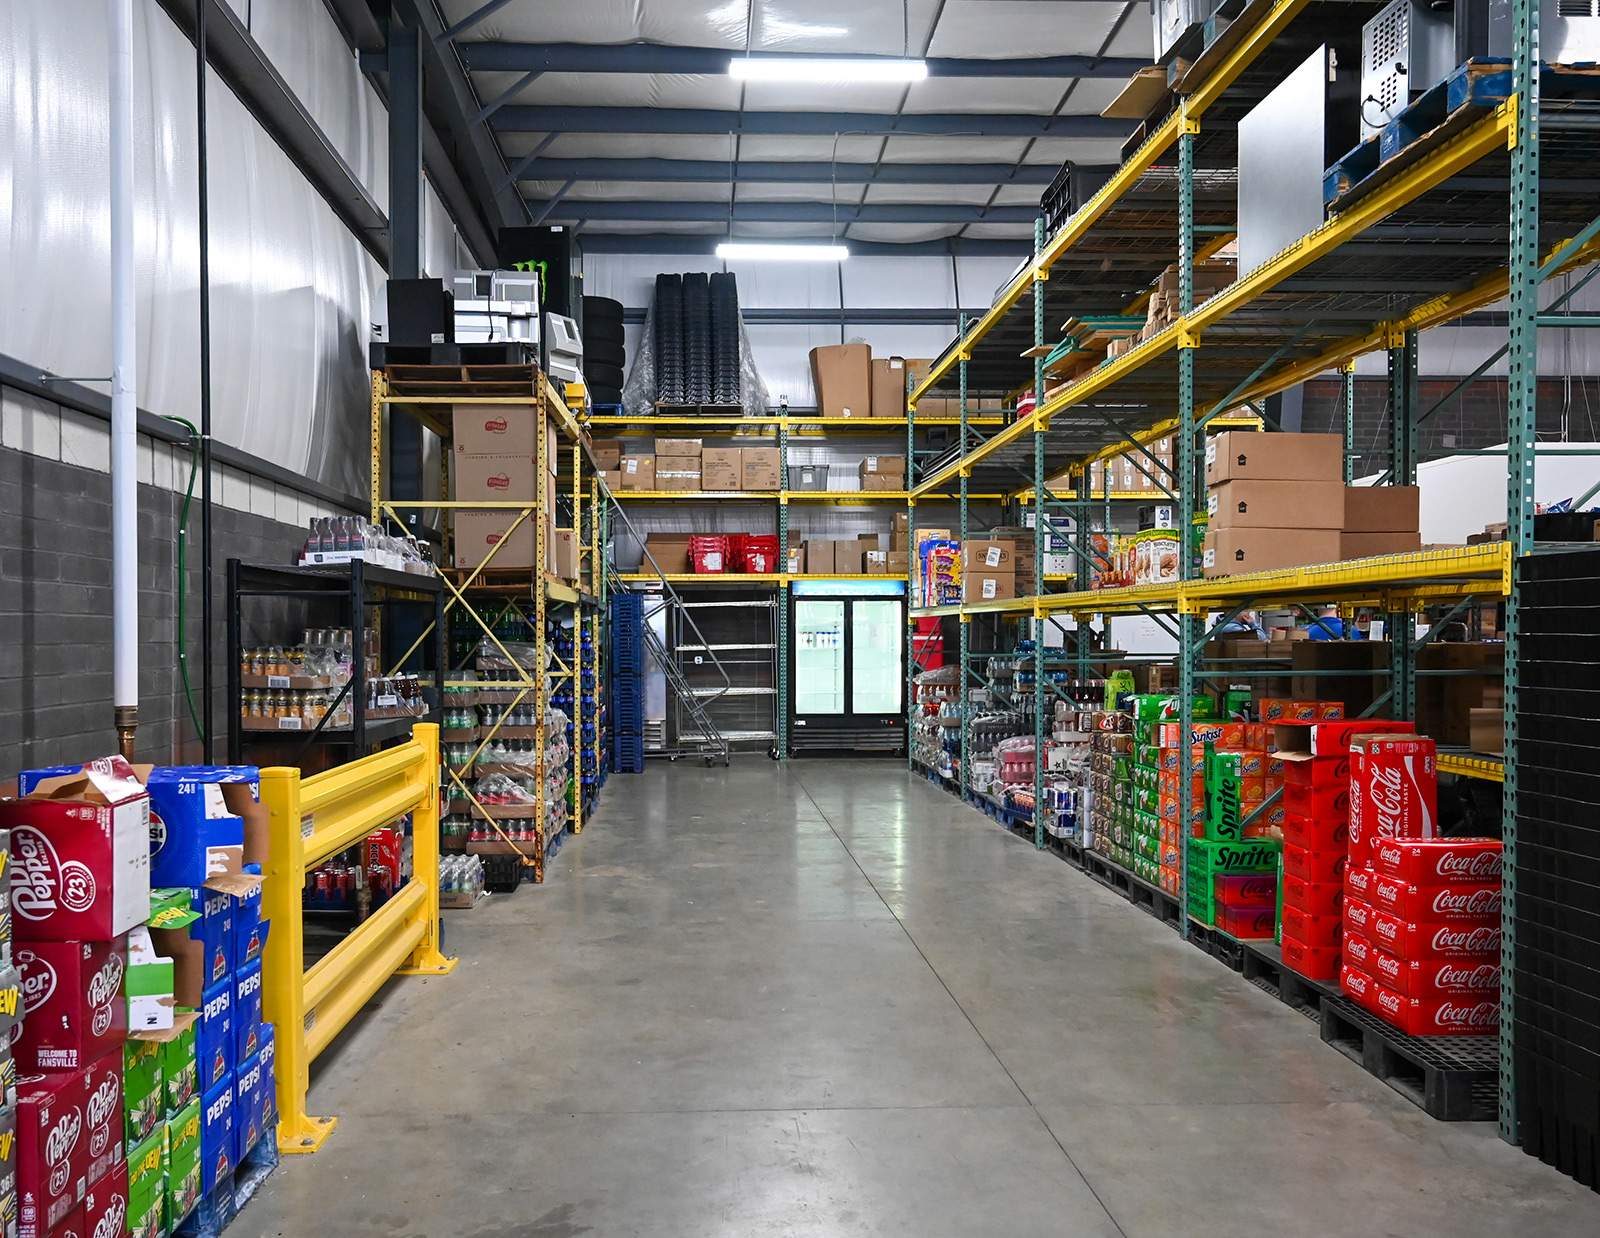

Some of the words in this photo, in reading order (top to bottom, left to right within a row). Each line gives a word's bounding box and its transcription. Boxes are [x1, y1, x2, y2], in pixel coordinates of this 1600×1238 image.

[1192, 728, 1224, 746] Sunkist
[178, 784, 190, 794] 24
[1216, 778, 1240, 840] Sprite
[1214, 846, 1276, 870] Sprite
[1436, 852, 1502, 875] Coca-Cola
[12, 832, 58, 920] Pepper
[67, 878, 87, 898] 23
[204, 893, 231, 919] PEPSI
[1432, 890, 1502, 912] Coca-Cola
[1432, 926, 1501, 950] Coca-Cola
[238, 972, 261, 999] PEPSI
[1434, 964, 1500, 988] Coca-Cola
[204, 990, 230, 1023] PEPSI
[1434, 1002, 1500, 1026] Coca-Cola
[38, 1050, 68, 1058] WELCOME
[38, 1058, 78, 1068] FANSVILLE
[260, 1039, 275, 1066] EPSI
[239, 1064, 260, 1097] PEPSI
[41, 1108, 49, 1122] 24
[207, 1086, 233, 1126] PEPSI
